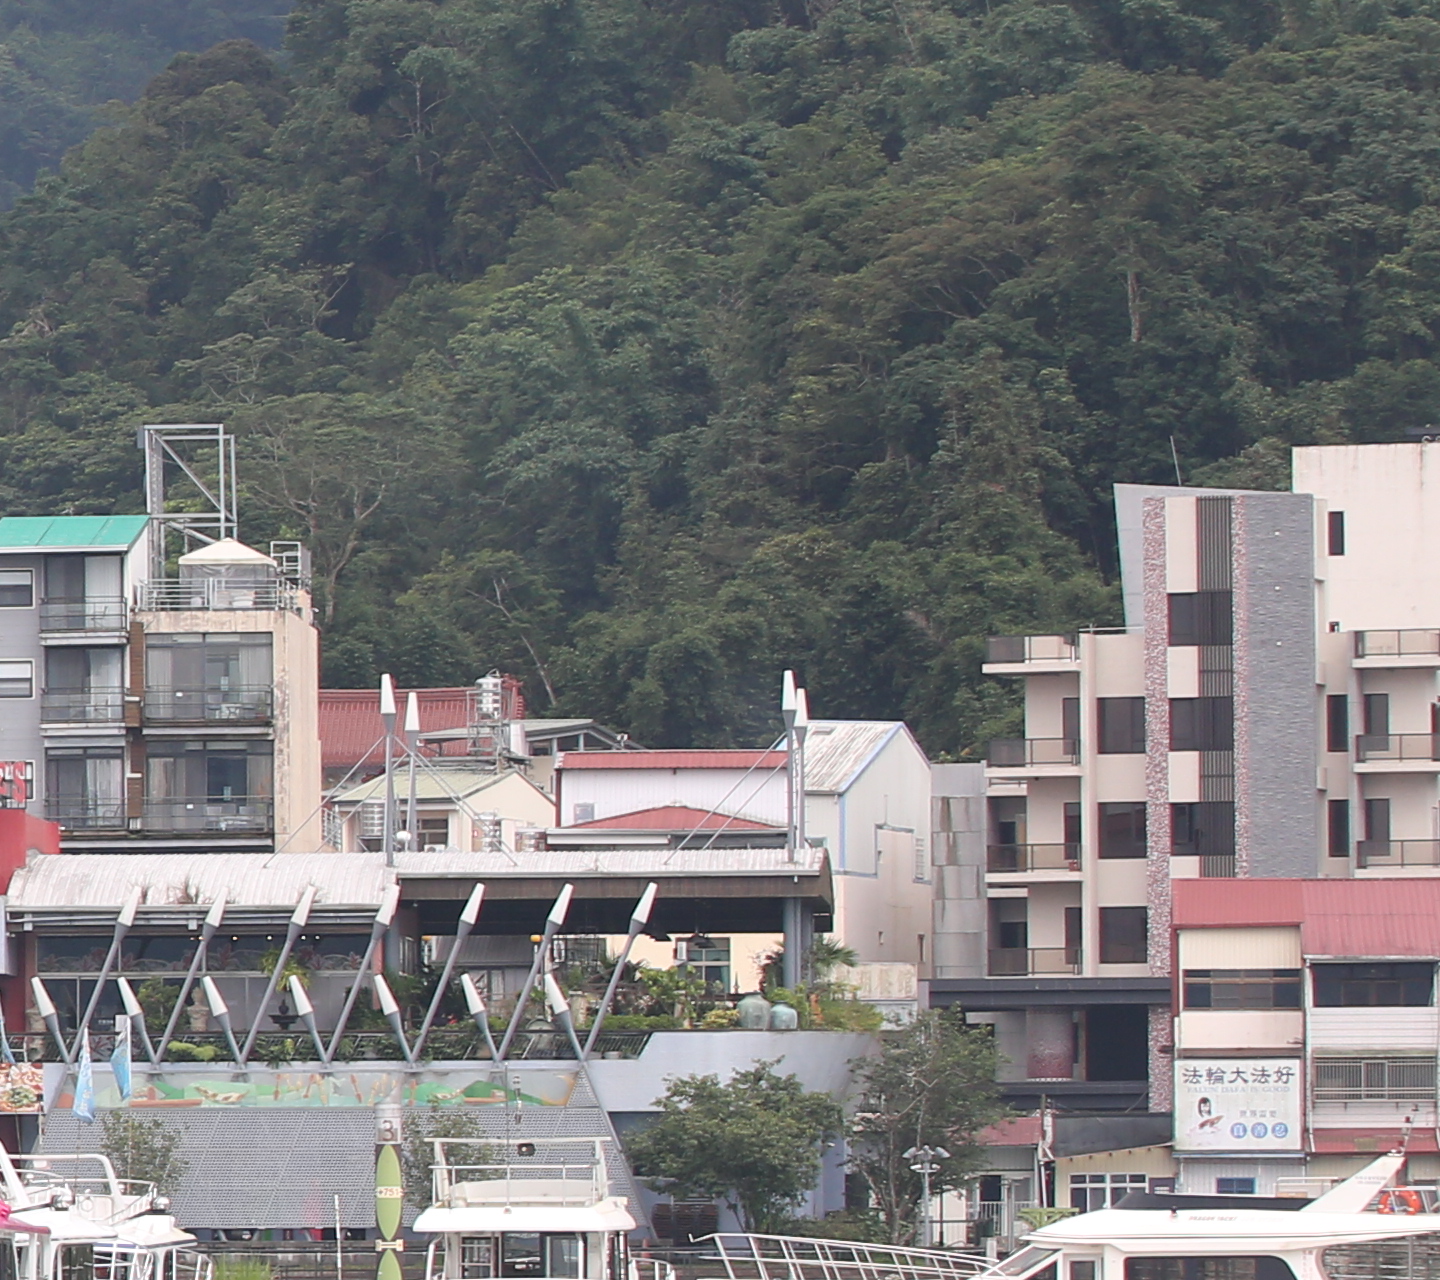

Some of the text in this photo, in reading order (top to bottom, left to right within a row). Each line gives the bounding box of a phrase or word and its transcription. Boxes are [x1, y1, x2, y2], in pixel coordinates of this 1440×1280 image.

[1181, 1065, 1296, 1086] 法輪大法好
[381, 1119, 395, 1142] 3
